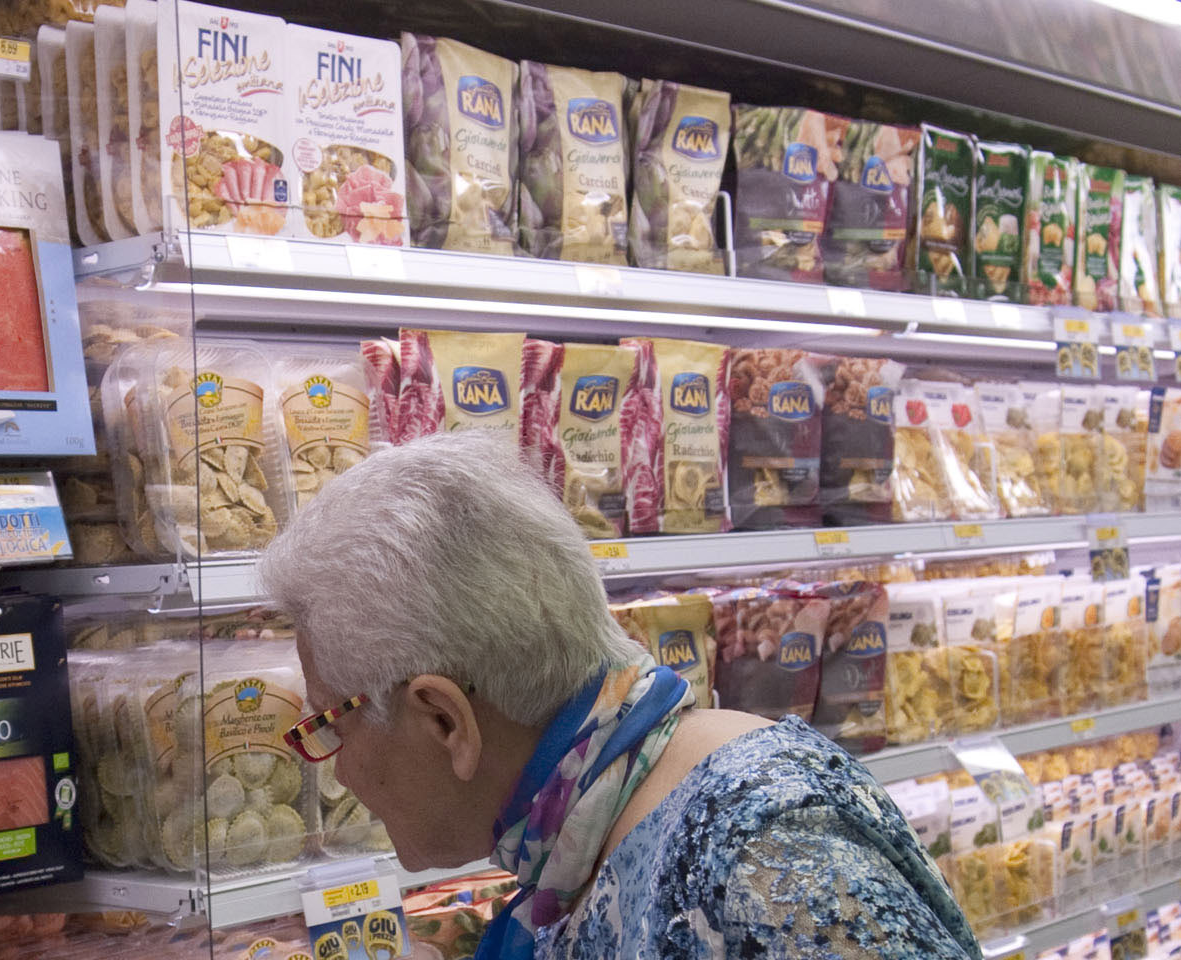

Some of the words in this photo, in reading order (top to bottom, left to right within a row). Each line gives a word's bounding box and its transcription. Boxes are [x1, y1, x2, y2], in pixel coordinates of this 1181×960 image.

[198, 27, 248, 65] FINI
[318, 51, 362, 86] FINI
[461, 92, 502, 122] RANA
[570, 114, 617, 138] RANA
[675, 132, 717, 155] RANA
[457, 383, 504, 407] RANA
[574, 391, 614, 413] RANA
[673, 386, 710, 408] RANA
[772, 396, 811, 415] RANA
[663, 644, 696, 665] RANA
[780, 647, 812, 663] RANA
[369, 915, 397, 936] GIÙ
[319, 935, 340, 957] GIÙ
